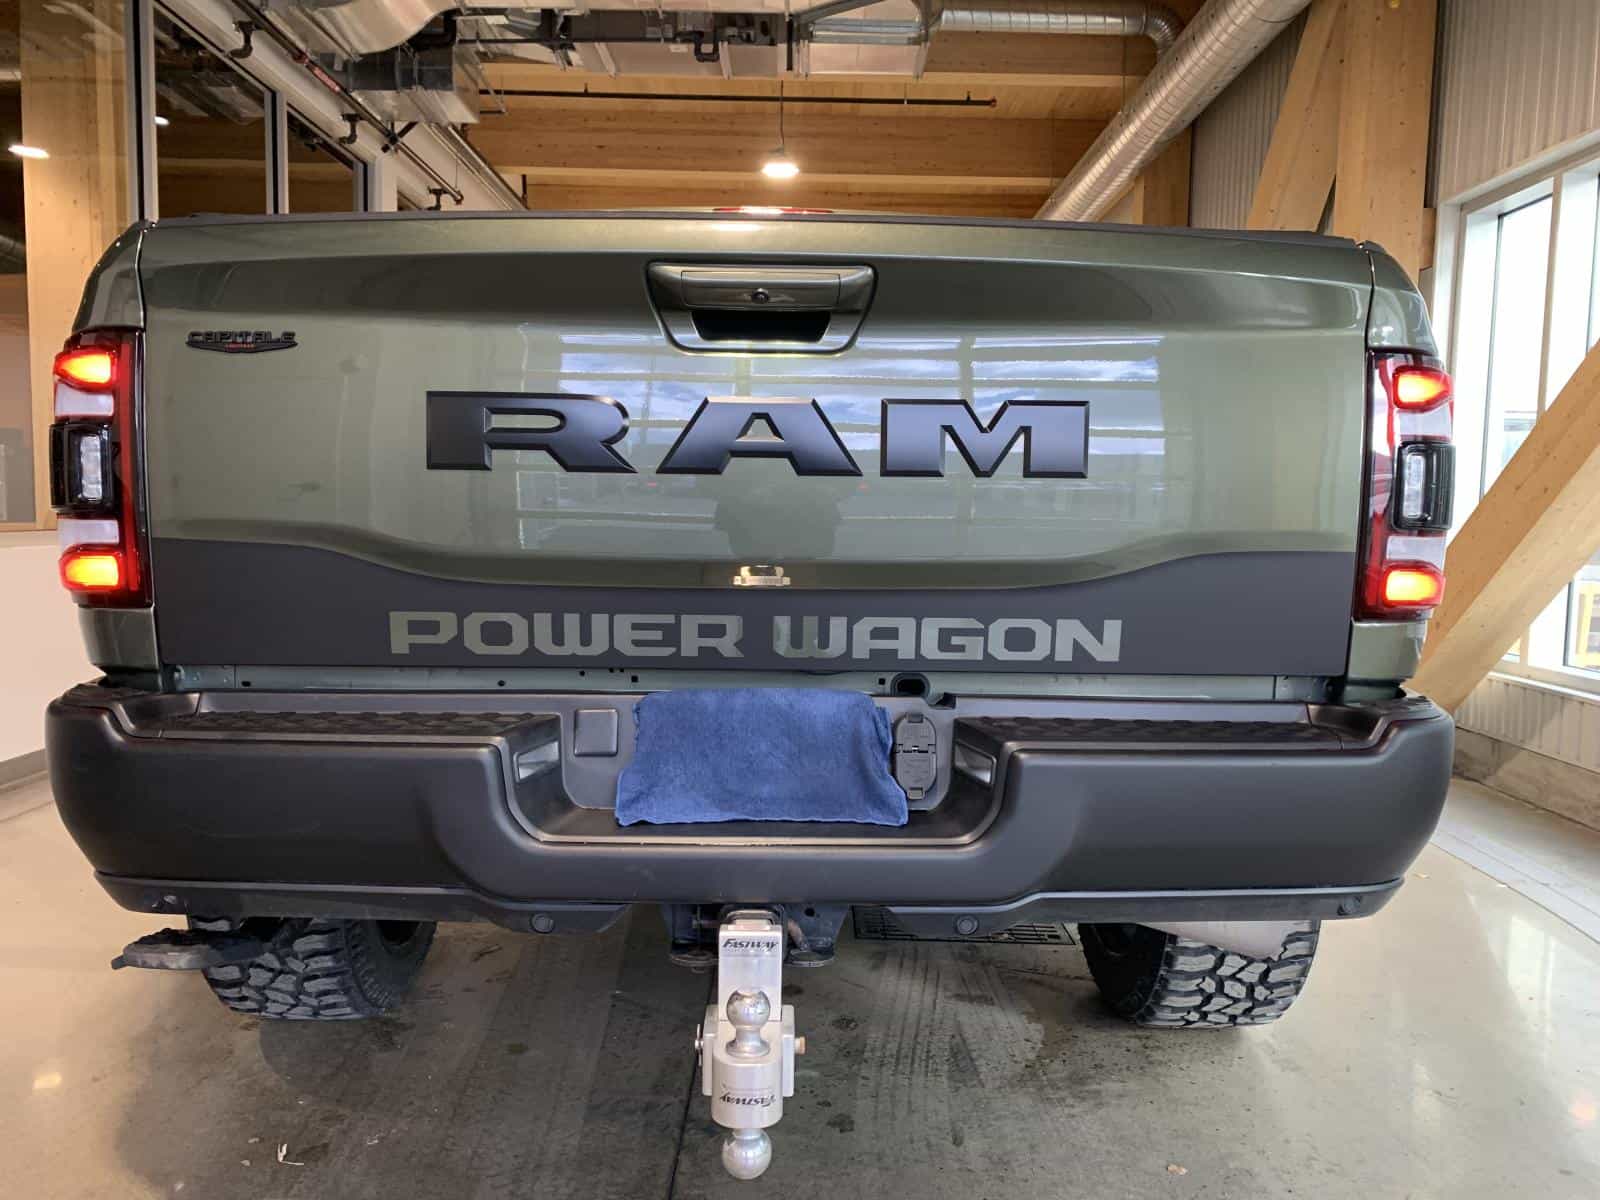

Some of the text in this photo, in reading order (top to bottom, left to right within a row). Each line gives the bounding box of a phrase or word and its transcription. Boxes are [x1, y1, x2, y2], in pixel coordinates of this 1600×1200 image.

[426, 390, 1090, 478] RAM
[389, 610, 1123, 663] POWER WAGON
